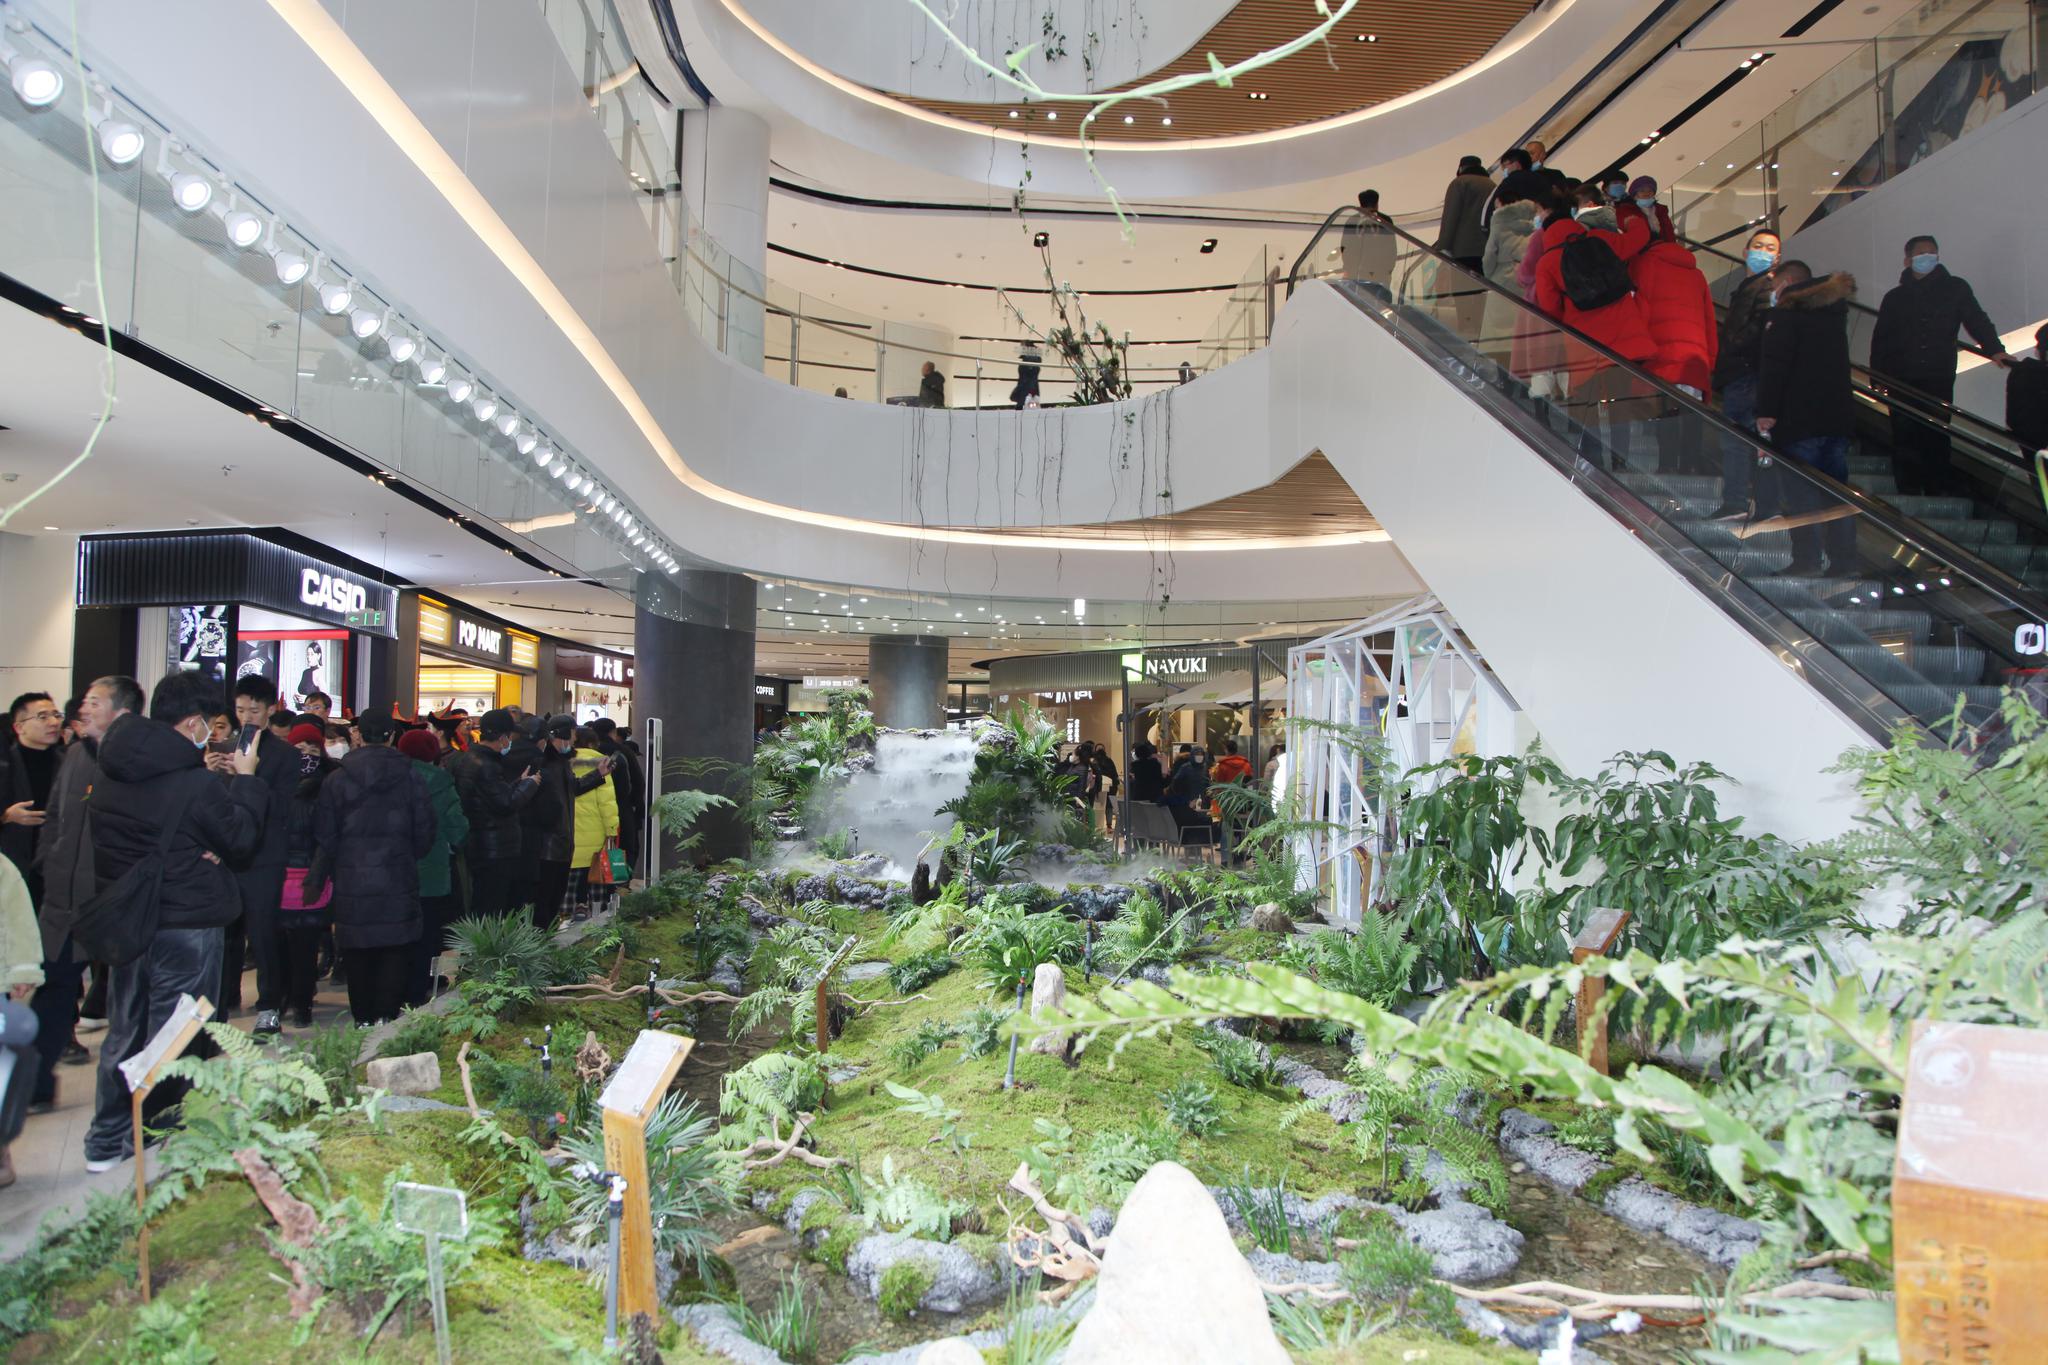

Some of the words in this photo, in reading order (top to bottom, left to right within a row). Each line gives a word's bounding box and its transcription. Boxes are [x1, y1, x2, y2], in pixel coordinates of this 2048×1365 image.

[301, 568, 366, 613] CASIO
[459, 619, 477, 647] POP
[477, 626, 501, 655] MART
[2014, 623, 2048, 655] O
[1146, 657, 1207, 674] NAYUKI
[755, 685, 775, 696] COFFEE
